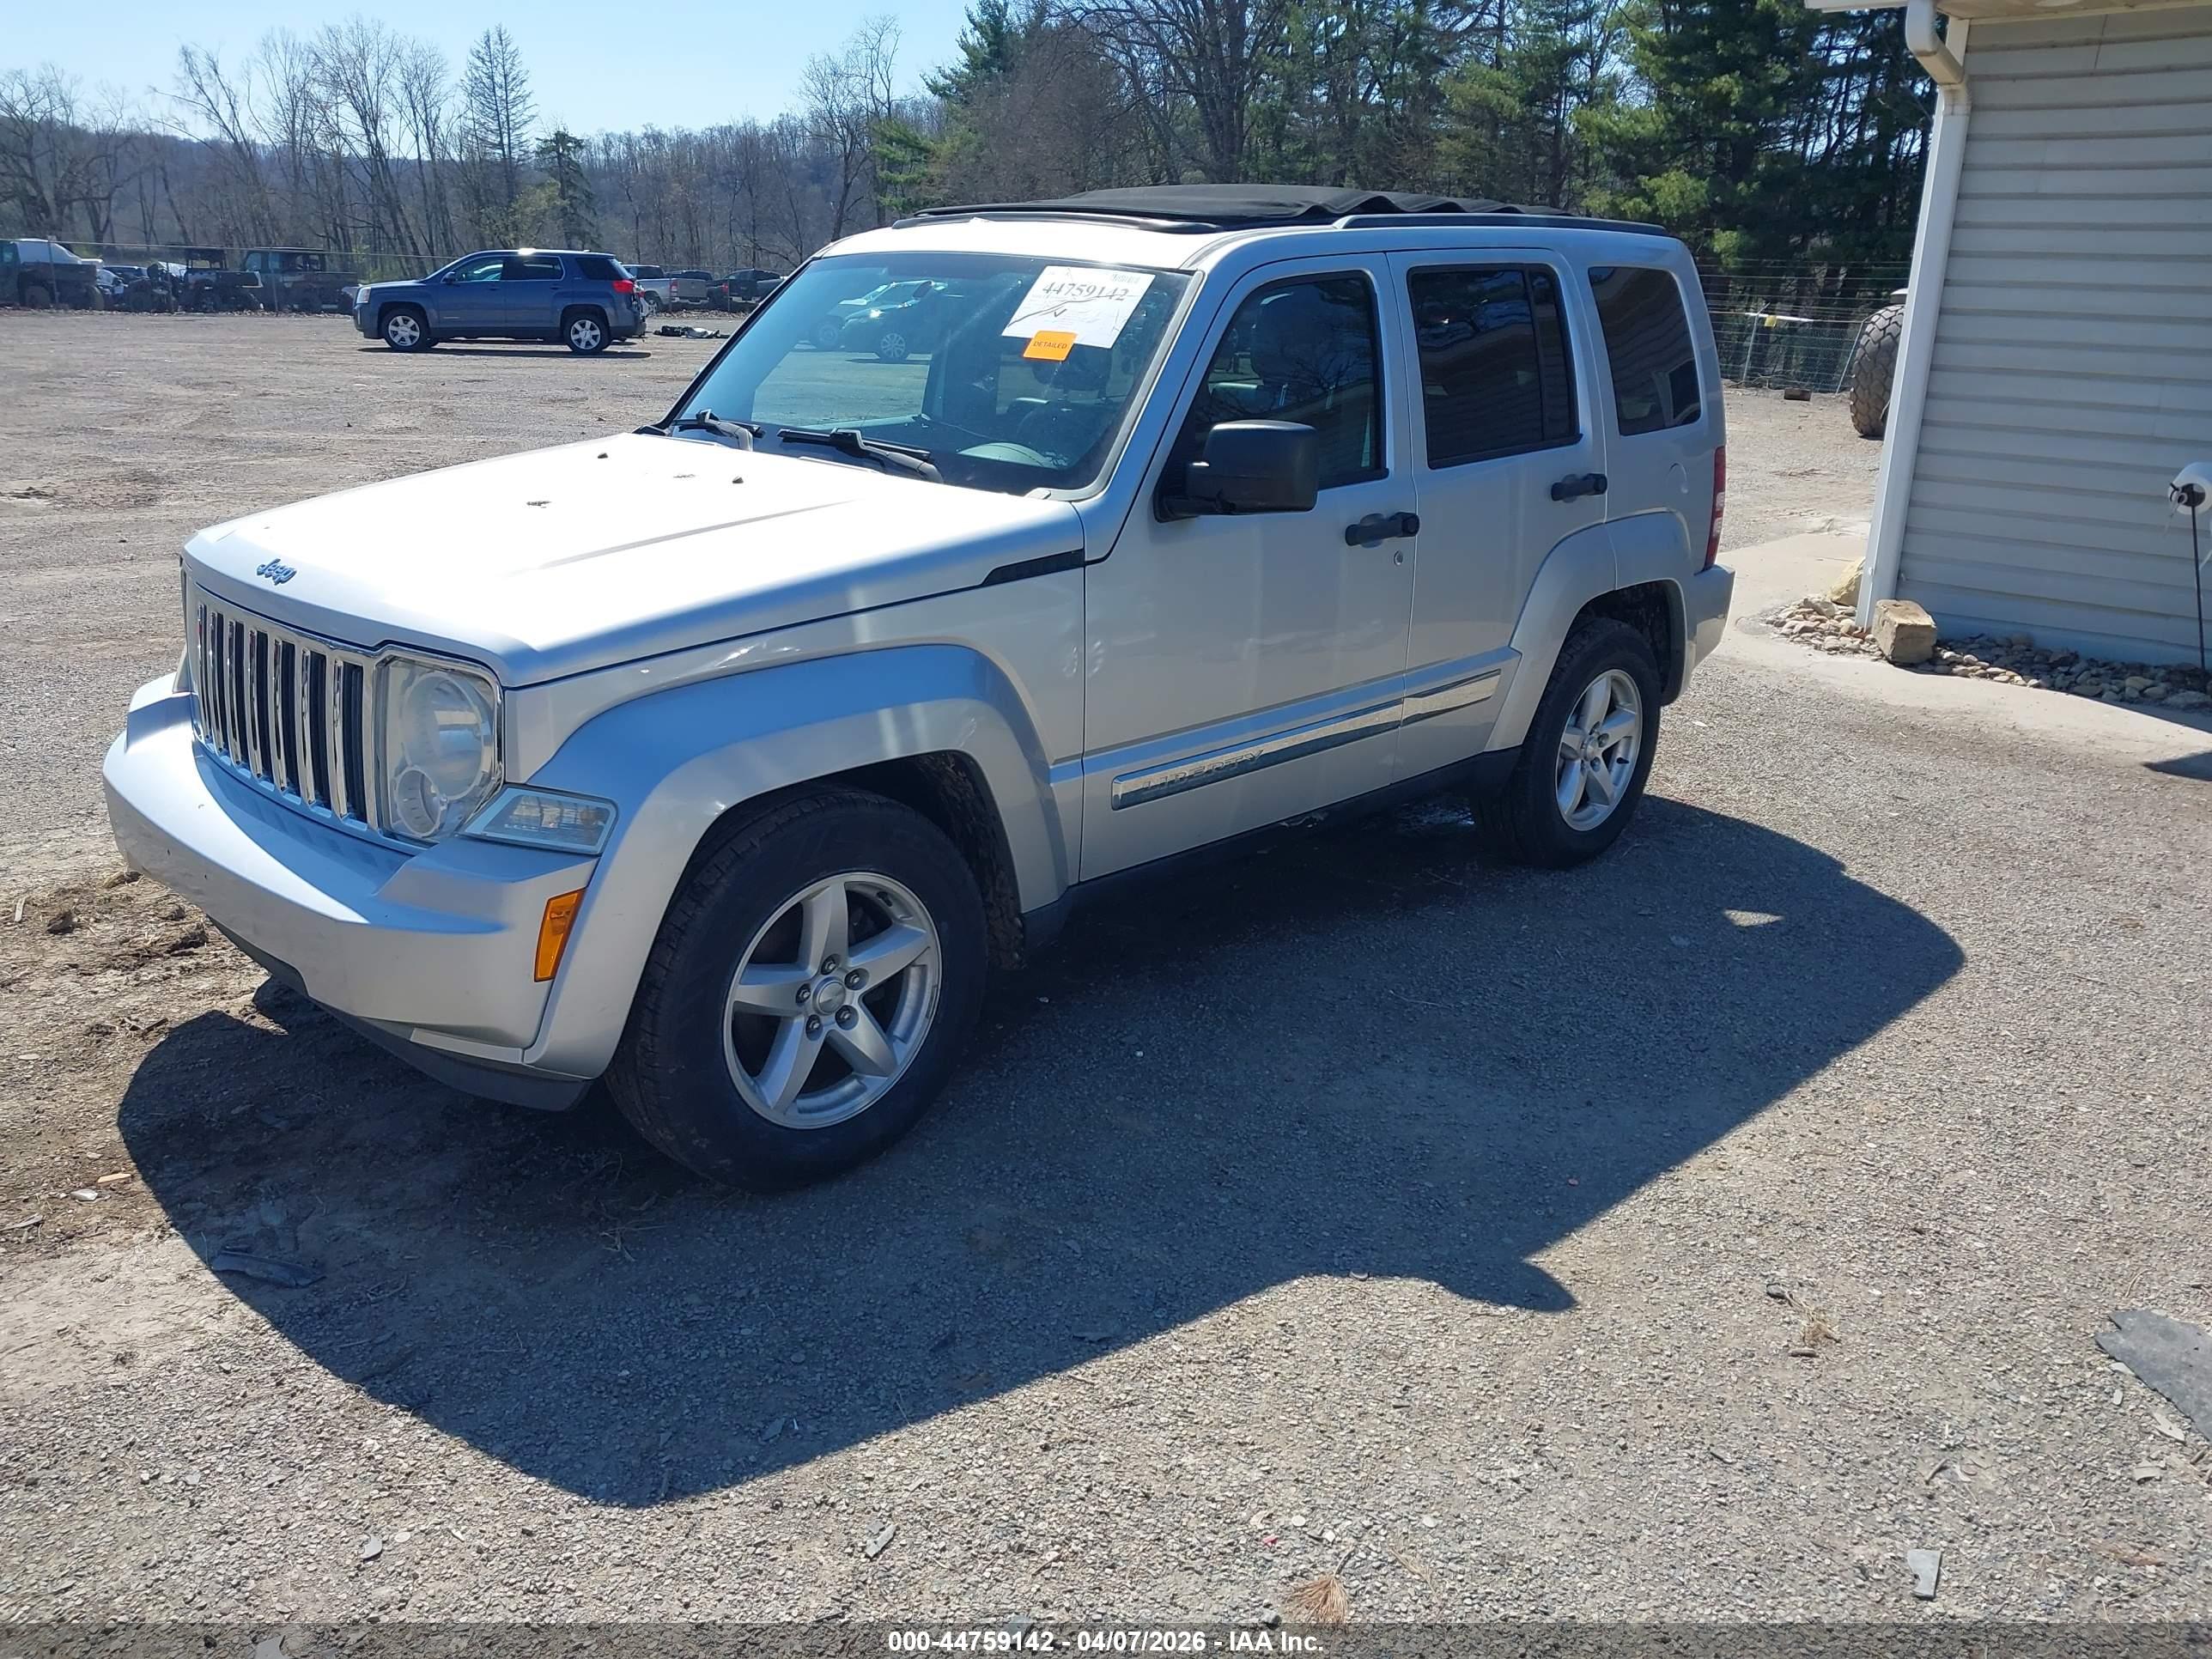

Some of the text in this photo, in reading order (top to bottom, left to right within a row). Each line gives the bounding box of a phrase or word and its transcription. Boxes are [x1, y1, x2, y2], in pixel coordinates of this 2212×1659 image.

[1042, 282, 1130, 301] 44759142
[1033, 341, 1067, 350] DETAILED
[257, 558, 297, 586] Jeep
